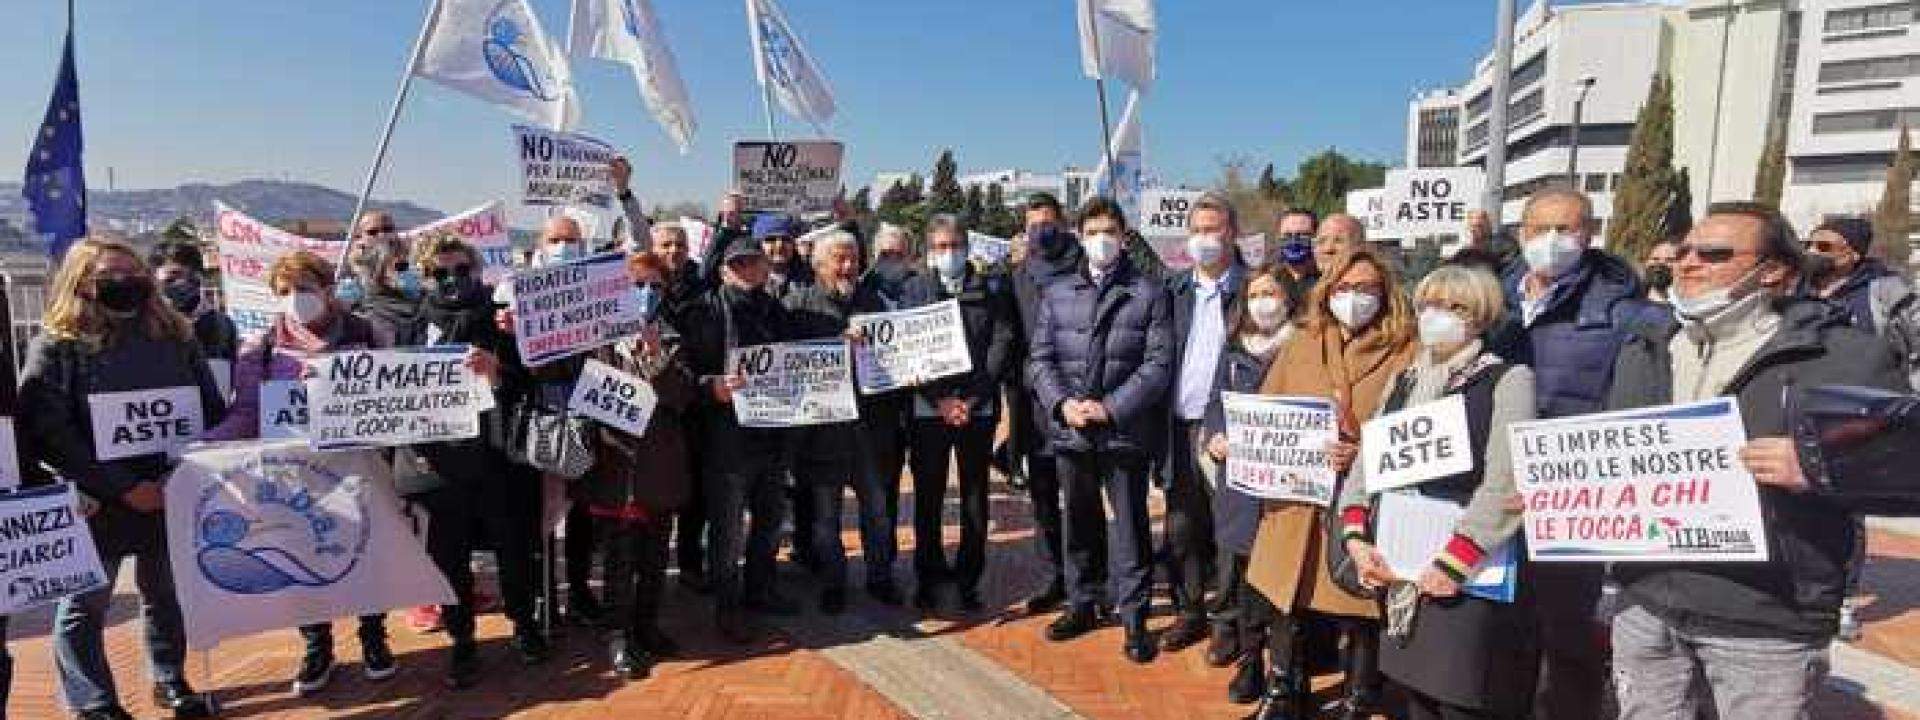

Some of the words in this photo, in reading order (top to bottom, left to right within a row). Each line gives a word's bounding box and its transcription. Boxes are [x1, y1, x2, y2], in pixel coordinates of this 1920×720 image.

[521, 134, 554, 162] NO
[762, 143, 797, 168] NO
[1411, 178, 1452, 199] NO
[1160, 196, 1189, 212] NO
[1367, 196, 1384, 212] N
[1396, 201, 1466, 223] ASTE
[1150, 213, 1188, 228] AST
[861, 319, 894, 346] NO
[331, 352, 374, 381] NO
[375, 358, 463, 390] MAFIE
[738, 347, 773, 376] NO
[288, 388, 308, 406] N
[602, 374, 636, 400] NO
[125, 399, 173, 419] NO
[273, 407, 308, 426] AS
[584, 388, 642, 422] ASTE
[112, 418, 192, 444] ASTE
[355, 415, 404, 436] COOP
[1389, 415, 1433, 446] NO
[1522, 434, 1548, 456] LE
[1557, 422, 1671, 453] IMPRESE
[1379, 437, 1454, 474] ASTE
[1527, 459, 1589, 482] SONO
[1598, 456, 1621, 478] LE
[1631, 447, 1730, 476] NOSTRE
[1531, 486, 1603, 511] GUAI
[1616, 483, 1637, 508] A
[1651, 477, 1711, 507] CHI
[0, 505, 74, 542] NNIZZI
[1535, 516, 1559, 540] LE
[1565, 514, 1644, 540] TOCCA
